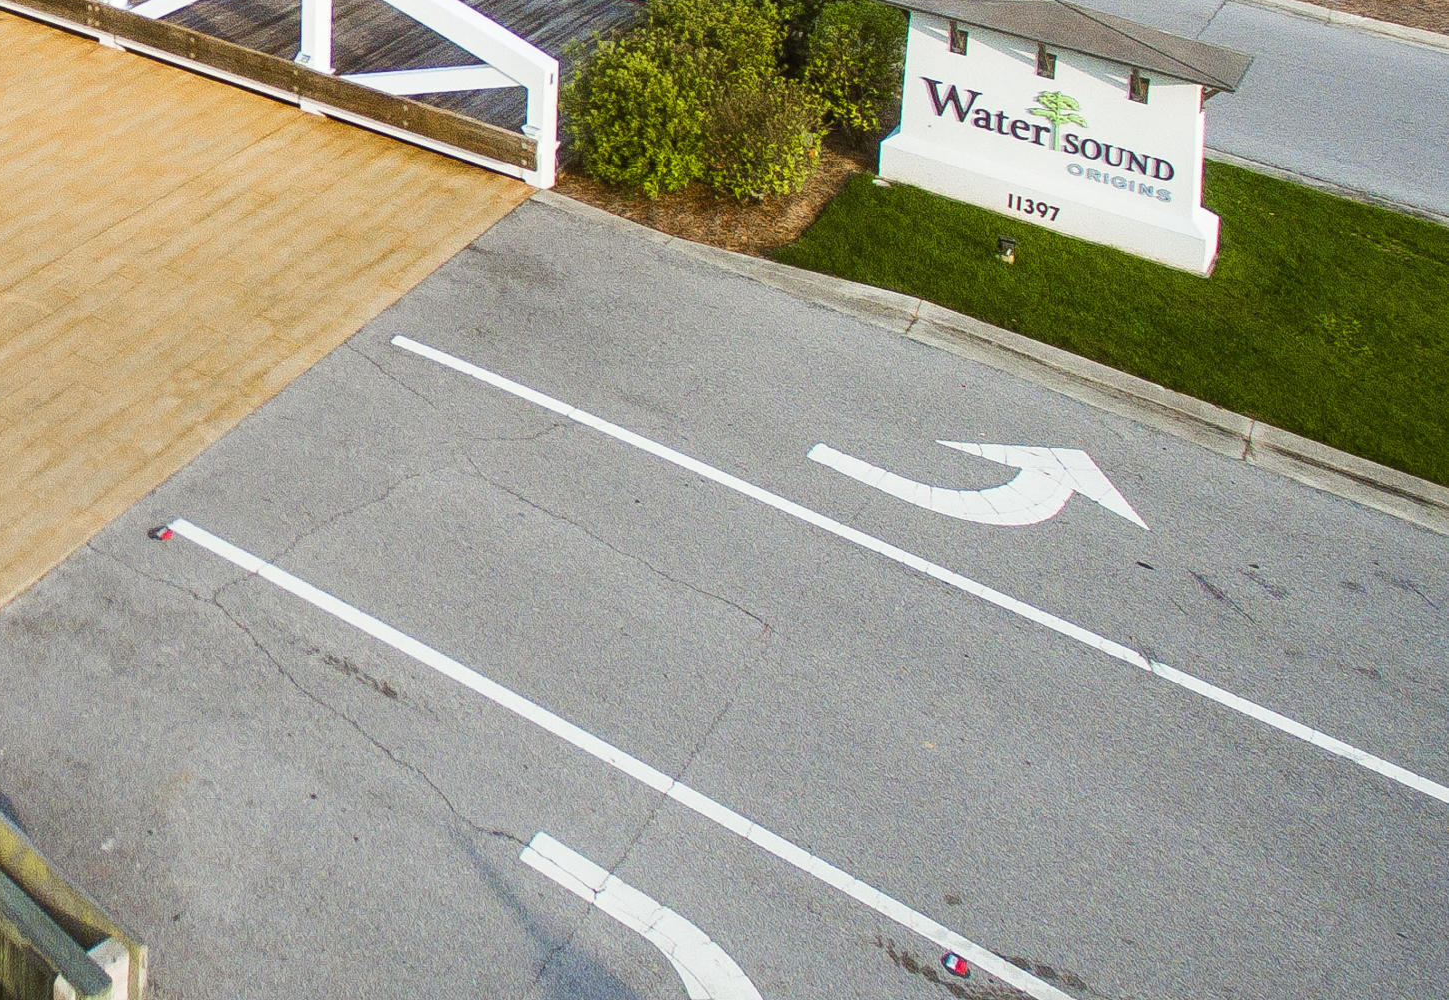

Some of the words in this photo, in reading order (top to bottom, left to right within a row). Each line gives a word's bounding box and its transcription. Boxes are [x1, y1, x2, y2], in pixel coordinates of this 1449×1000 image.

[920, 76, 1051, 147] Water
[1063, 133, 1175, 182] SOUND
[1066, 162, 1172, 204] ORIGINS
[1007, 193, 1060, 222] 11397
